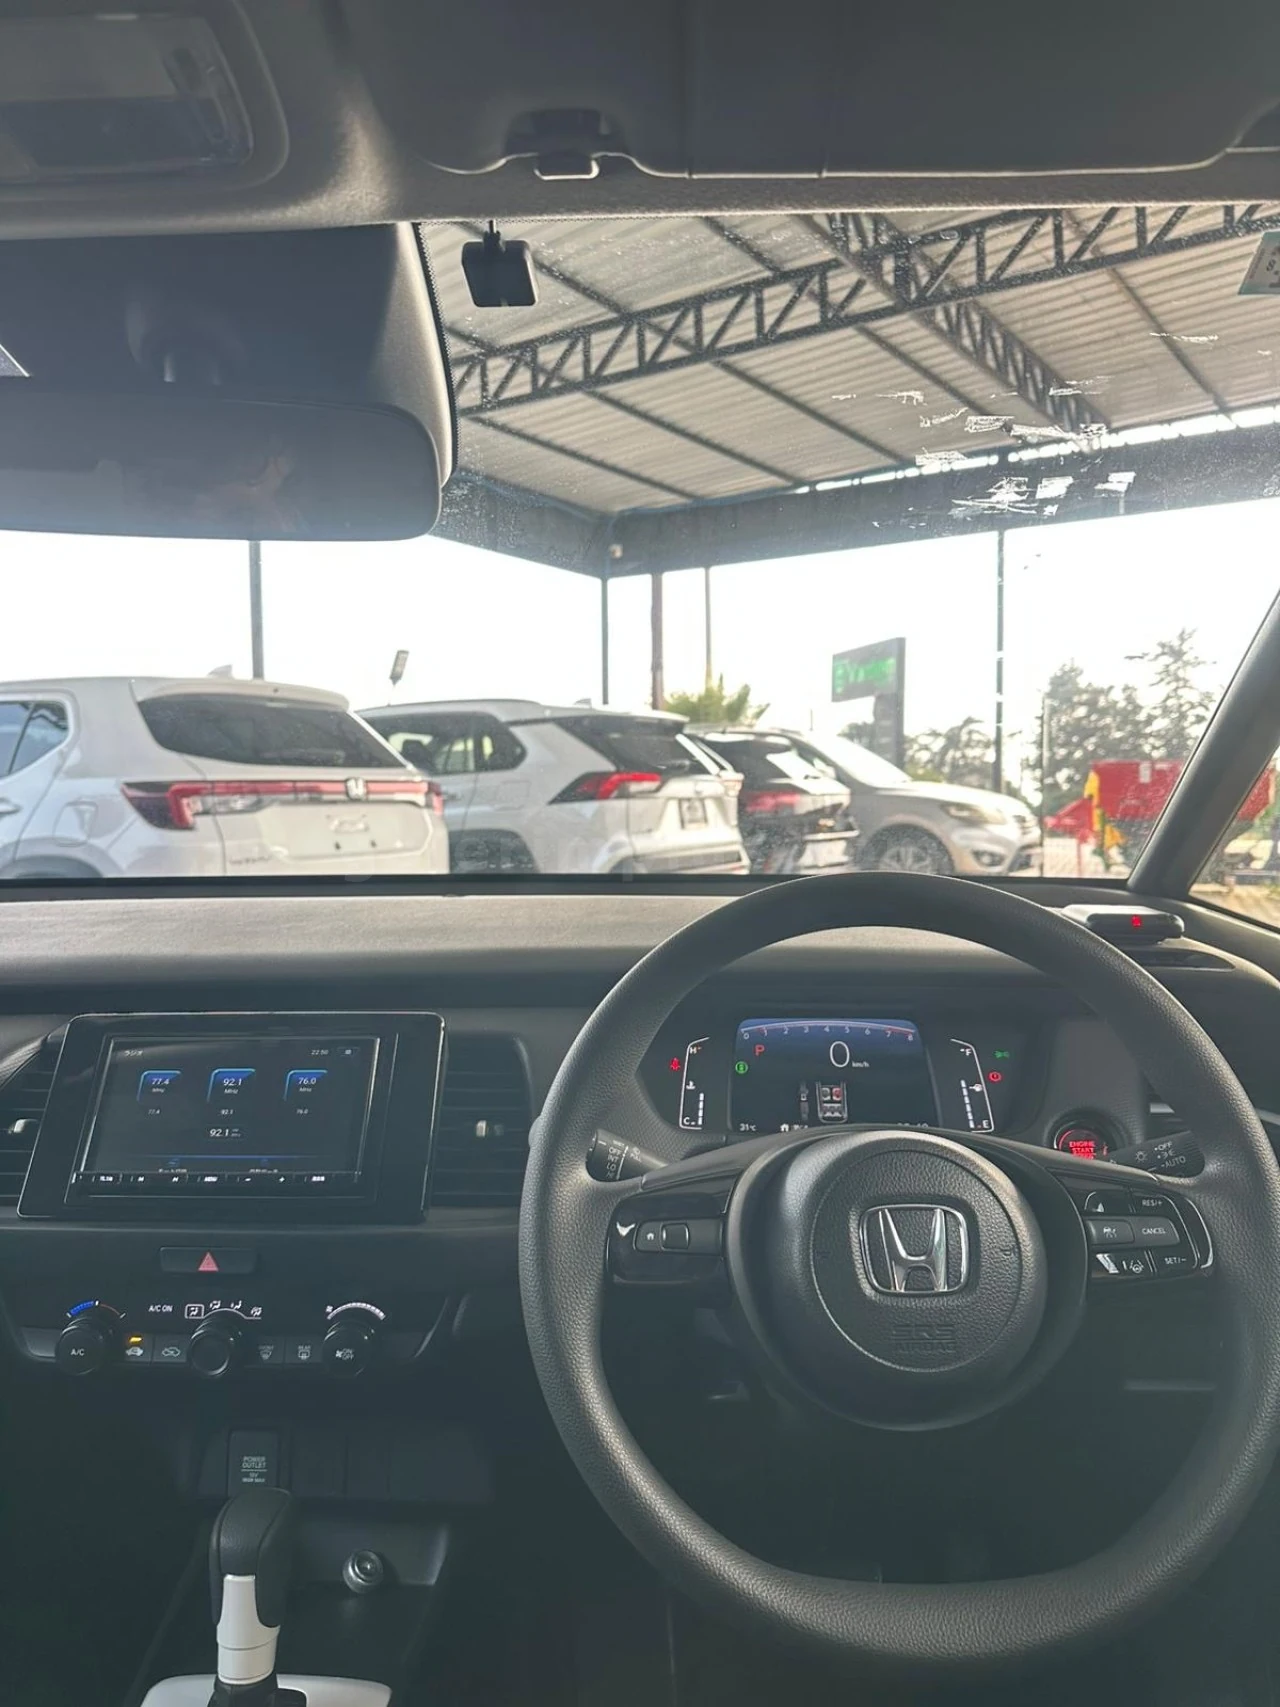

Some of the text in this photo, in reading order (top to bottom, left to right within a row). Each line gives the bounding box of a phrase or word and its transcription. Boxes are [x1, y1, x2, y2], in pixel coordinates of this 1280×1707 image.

[689, 1046, 697, 1054] H
[755, 1044, 765, 1056] P
[965, 1048, 972, 1056] F
[829, 1041, 850, 1068] 0
[223, 1078, 242, 1086] 92.1
[298, 1077, 317, 1085] 76.0
[683, 1117, 690, 1125] C
[982, 1120, 989, 1128] E
[209, 1128, 229, 1137] 92.1
[1158, 1141, 1173, 1151] OFF
[1165, 1155, 1187, 1169] AUTO
[1141, 1227, 1167, 1235] CANCEL
[148, 1304, 173, 1313] A/C ON
[70, 1348, 85, 1356] A/C
